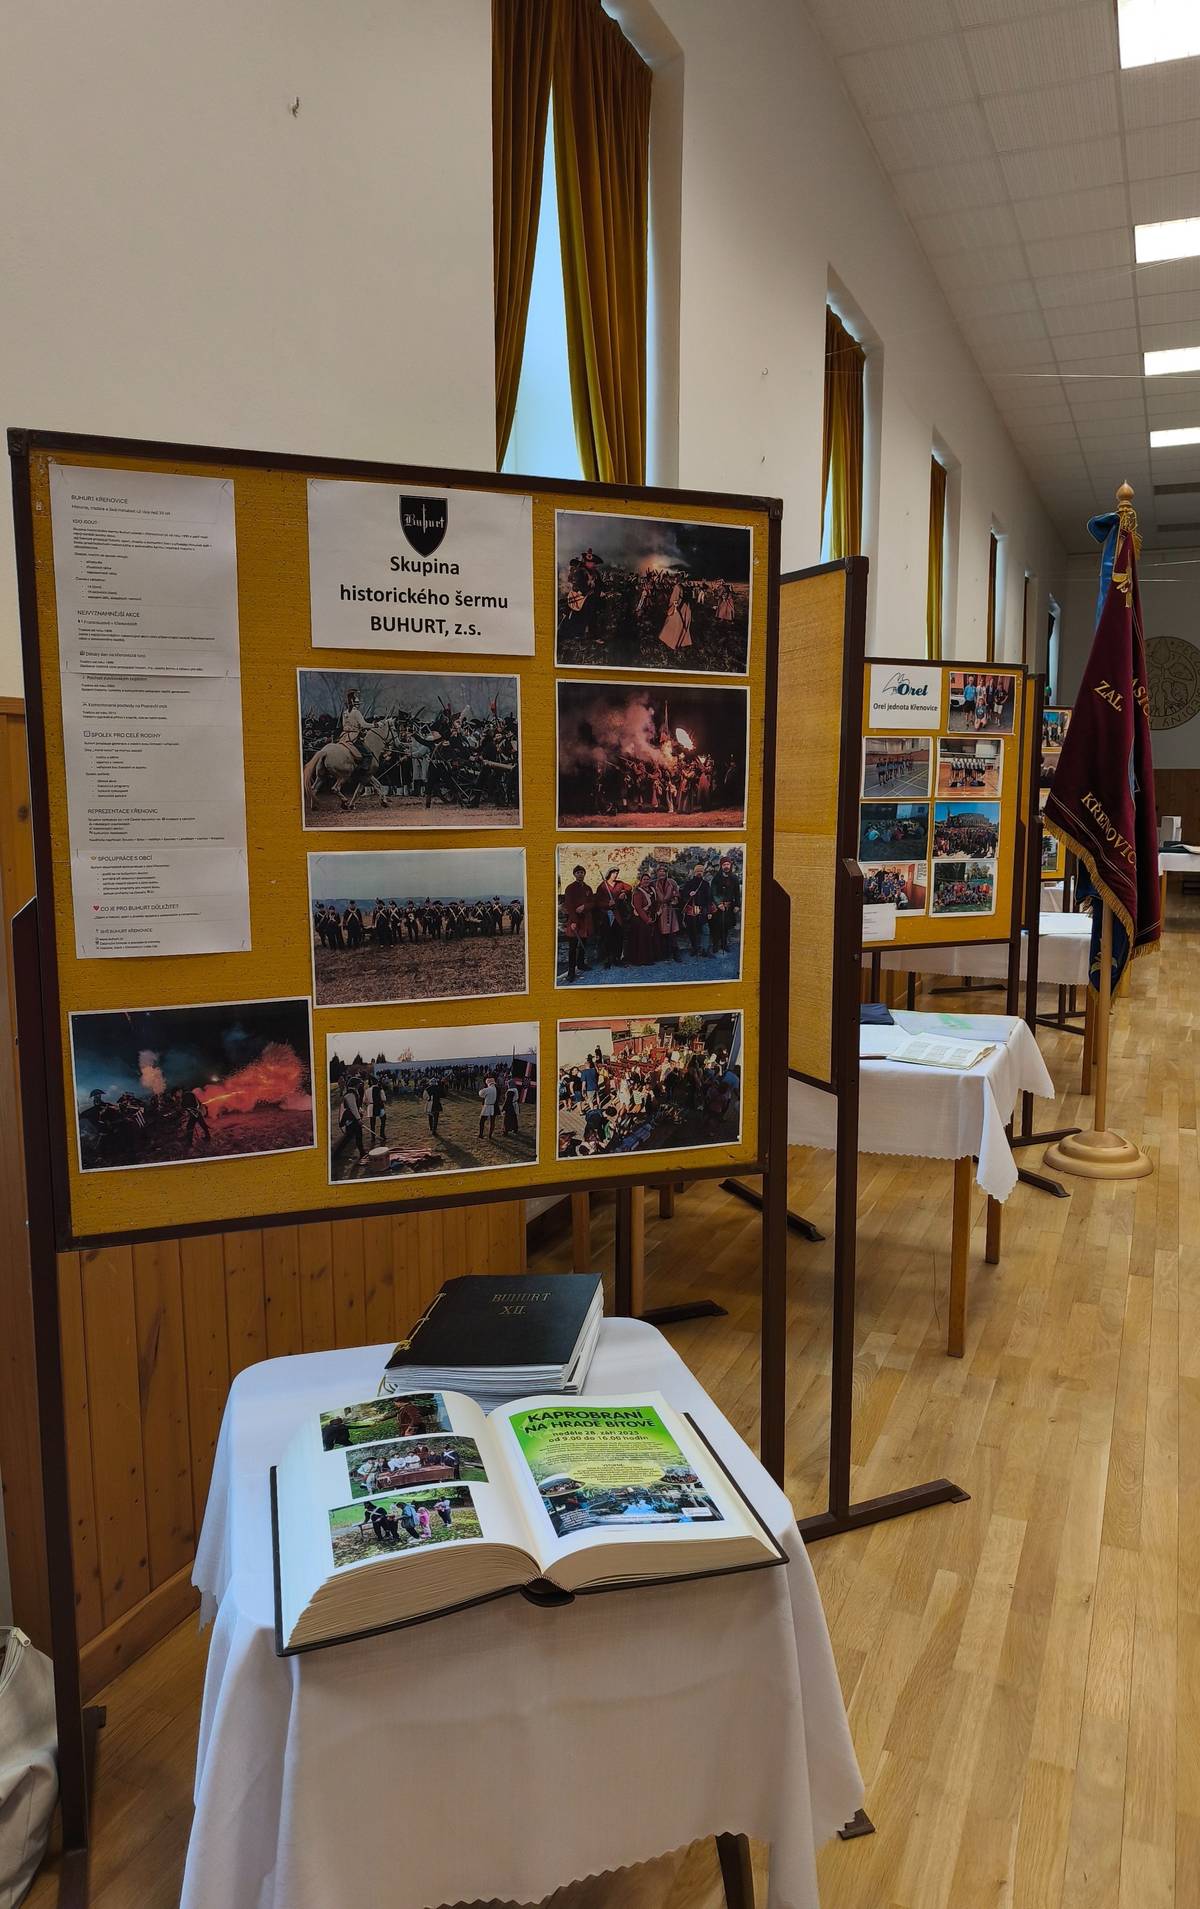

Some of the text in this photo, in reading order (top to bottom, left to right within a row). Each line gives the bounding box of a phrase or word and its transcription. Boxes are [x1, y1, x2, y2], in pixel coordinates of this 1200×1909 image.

[403, 512, 445, 534] Buhurt
[390, 556, 460, 576] Skupina
[340, 584, 508, 609] historického šermu
[370, 616, 481, 638] BUHURT, z.s.
[897, 683, 928, 696] Orel
[1093, 680, 1123, 712] ZAL.
[873, 702, 938, 711] Orel jednota Křenovice
[1080, 792, 1136, 869] KŘENOVIC
[491, 1292, 551, 1303] BUHURT
[527, 1408, 643, 1423] KAPROBRANÍ
[524, 1423, 548, 1434] NA
[548, 1435, 561, 1443] od
